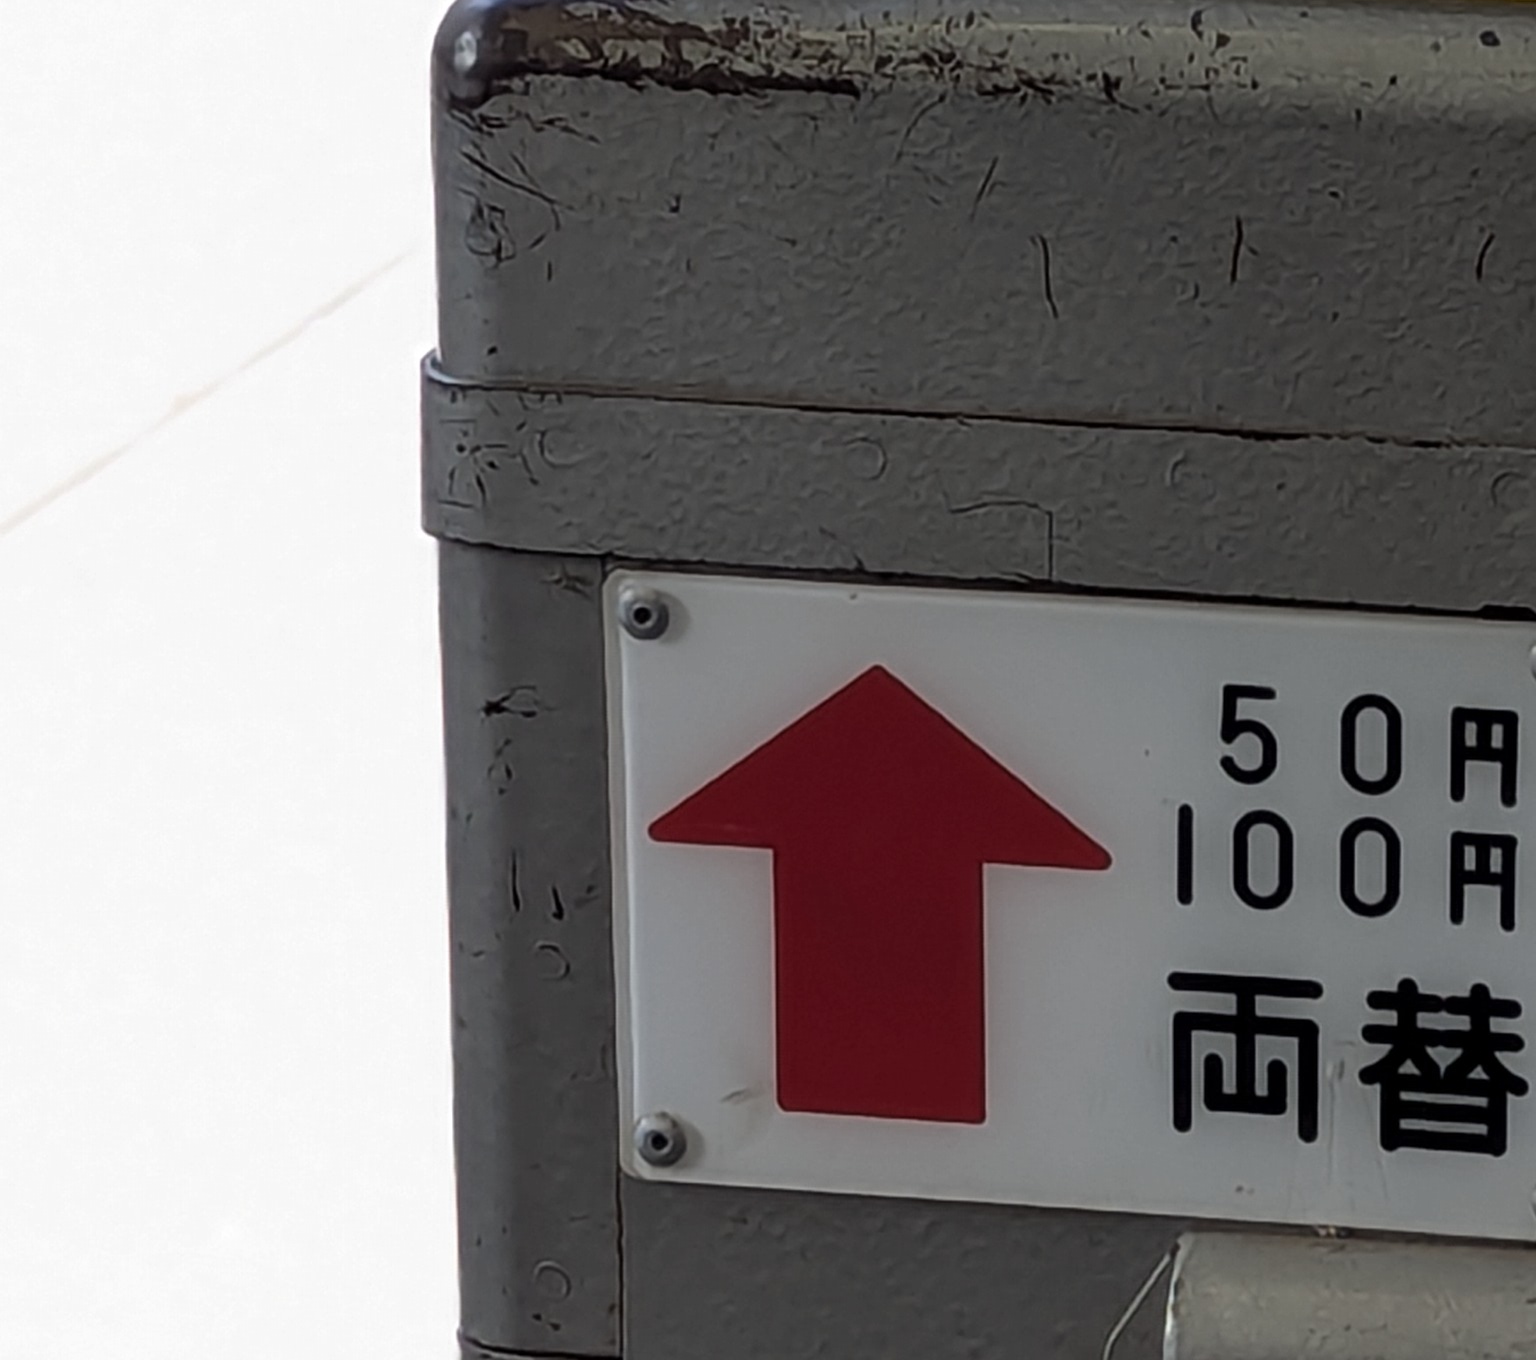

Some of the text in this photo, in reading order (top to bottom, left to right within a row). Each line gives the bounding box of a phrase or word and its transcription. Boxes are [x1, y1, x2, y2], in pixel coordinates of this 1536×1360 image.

[1219, 683, 1519, 808] 50円
[1176, 803, 1518, 932] 100円
[1167, 971, 1530, 1157] 両替
